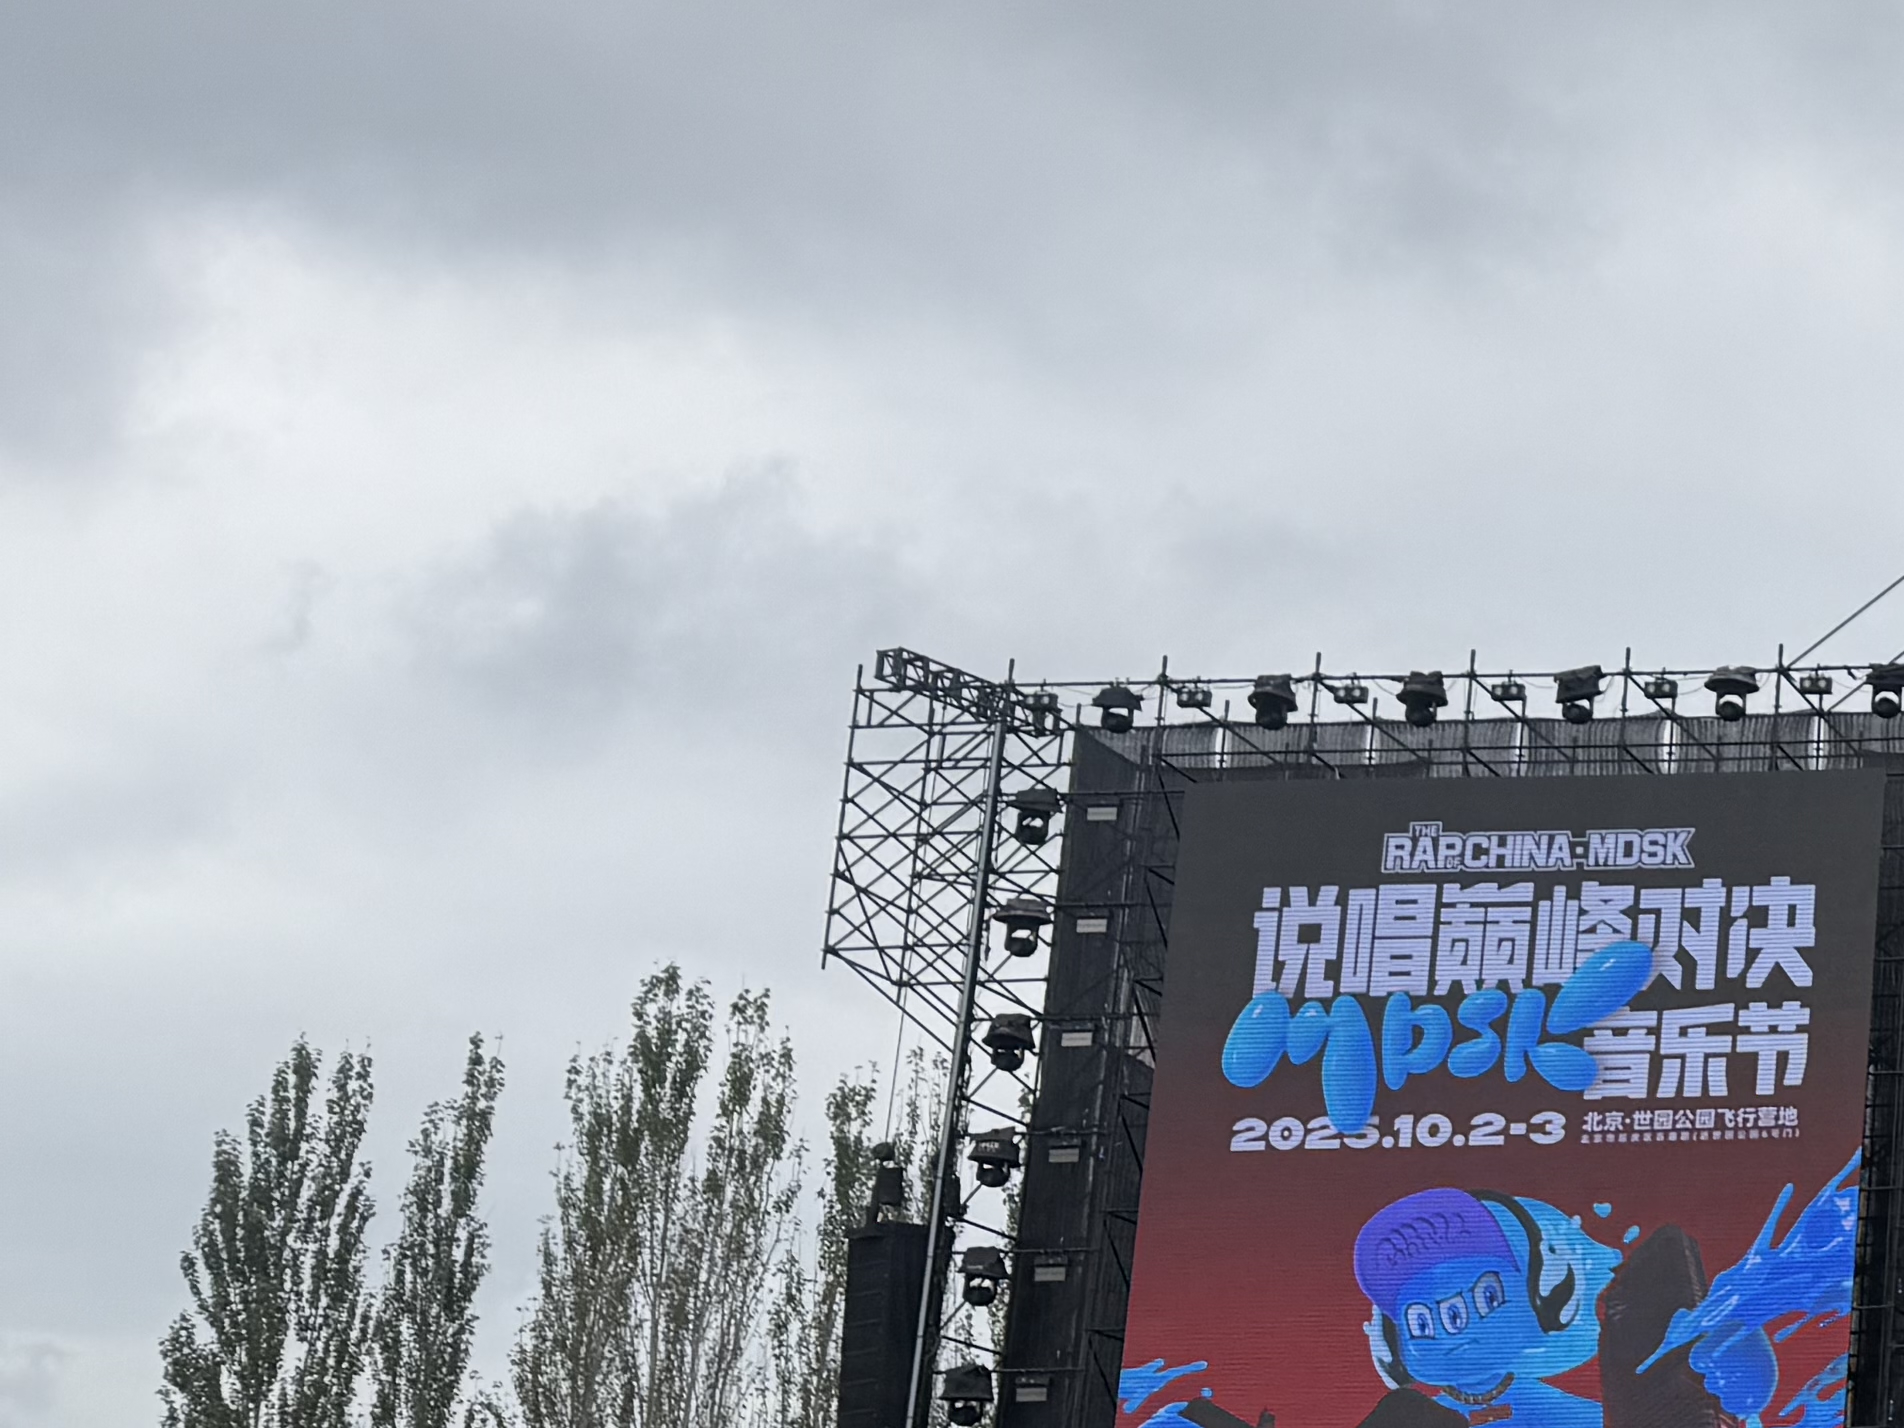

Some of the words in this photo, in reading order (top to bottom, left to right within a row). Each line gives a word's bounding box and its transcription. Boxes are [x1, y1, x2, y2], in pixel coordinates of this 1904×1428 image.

[1253, 876, 1816, 999] 说唱巅峰对决
[1582, 1002, 1811, 1099] 音乐节
